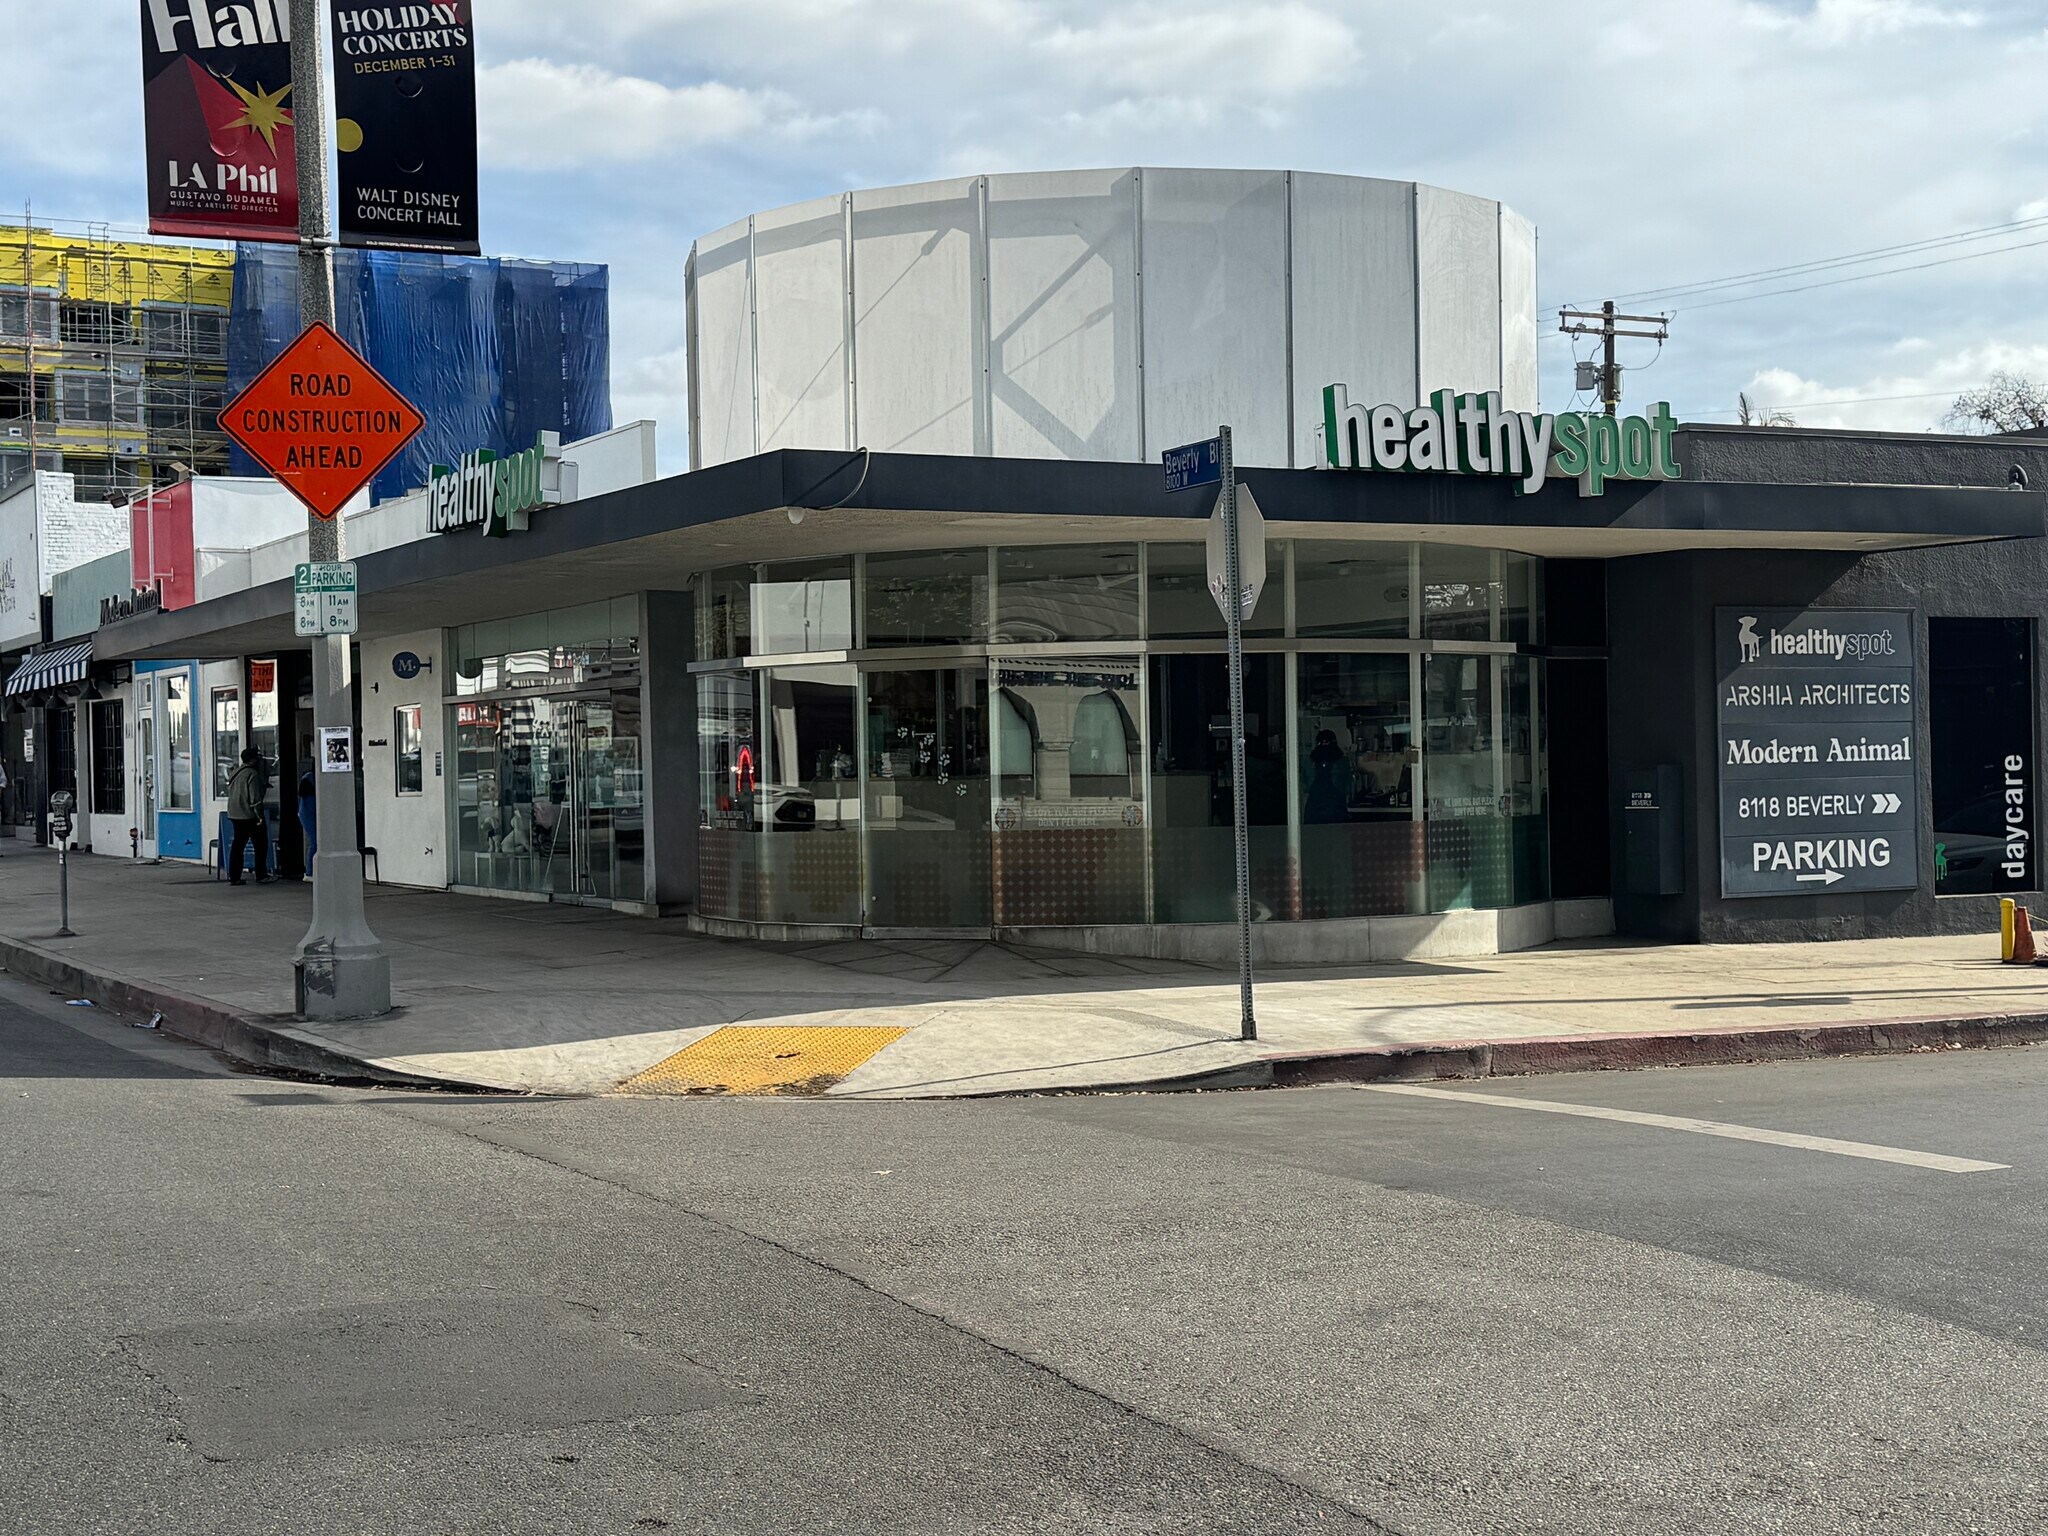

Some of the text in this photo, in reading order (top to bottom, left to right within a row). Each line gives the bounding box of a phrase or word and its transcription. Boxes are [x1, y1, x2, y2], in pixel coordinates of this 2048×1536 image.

[338, 3, 458, 33] HOLIDAY
[343, 27, 467, 55] CONCERTS
[354, 57, 426, 74] DECEMBER
[169, 160, 278, 194] LA Phil
[169, 191, 278, 206] GUSTAVO DUDAMEL
[205, 202, 239, 210] ARTISTIC
[242, 205, 278, 213] DIRECTOR
[356, 187, 460, 208] WALT DISNEY
[357, 205, 462, 226] CONCERT HALL
[290, 373, 351, 396] ROAD
[243, 409, 401, 433] CONSTRUCTION
[1323, 383, 1682, 496] healthyspot
[285, 445, 363, 468] AHEAD
[1165, 449, 1200, 475] Beverly
[427, 430, 555, 536] healthyspot
[1182, 470, 1189, 486] W
[299, 566, 308, 584] 2
[312, 572, 352, 585] PARKING
[1770, 629, 1896, 660] healthyspot
[1725, 684, 1910, 706] ARSHIA ARCHITECTS
[1727, 736, 1912, 765] Modern Animal
[1739, 794, 1866, 818] 8118 BEVERLY
[2001, 755, 2030, 879] daycare
[1753, 838, 1890, 872] PARKING
